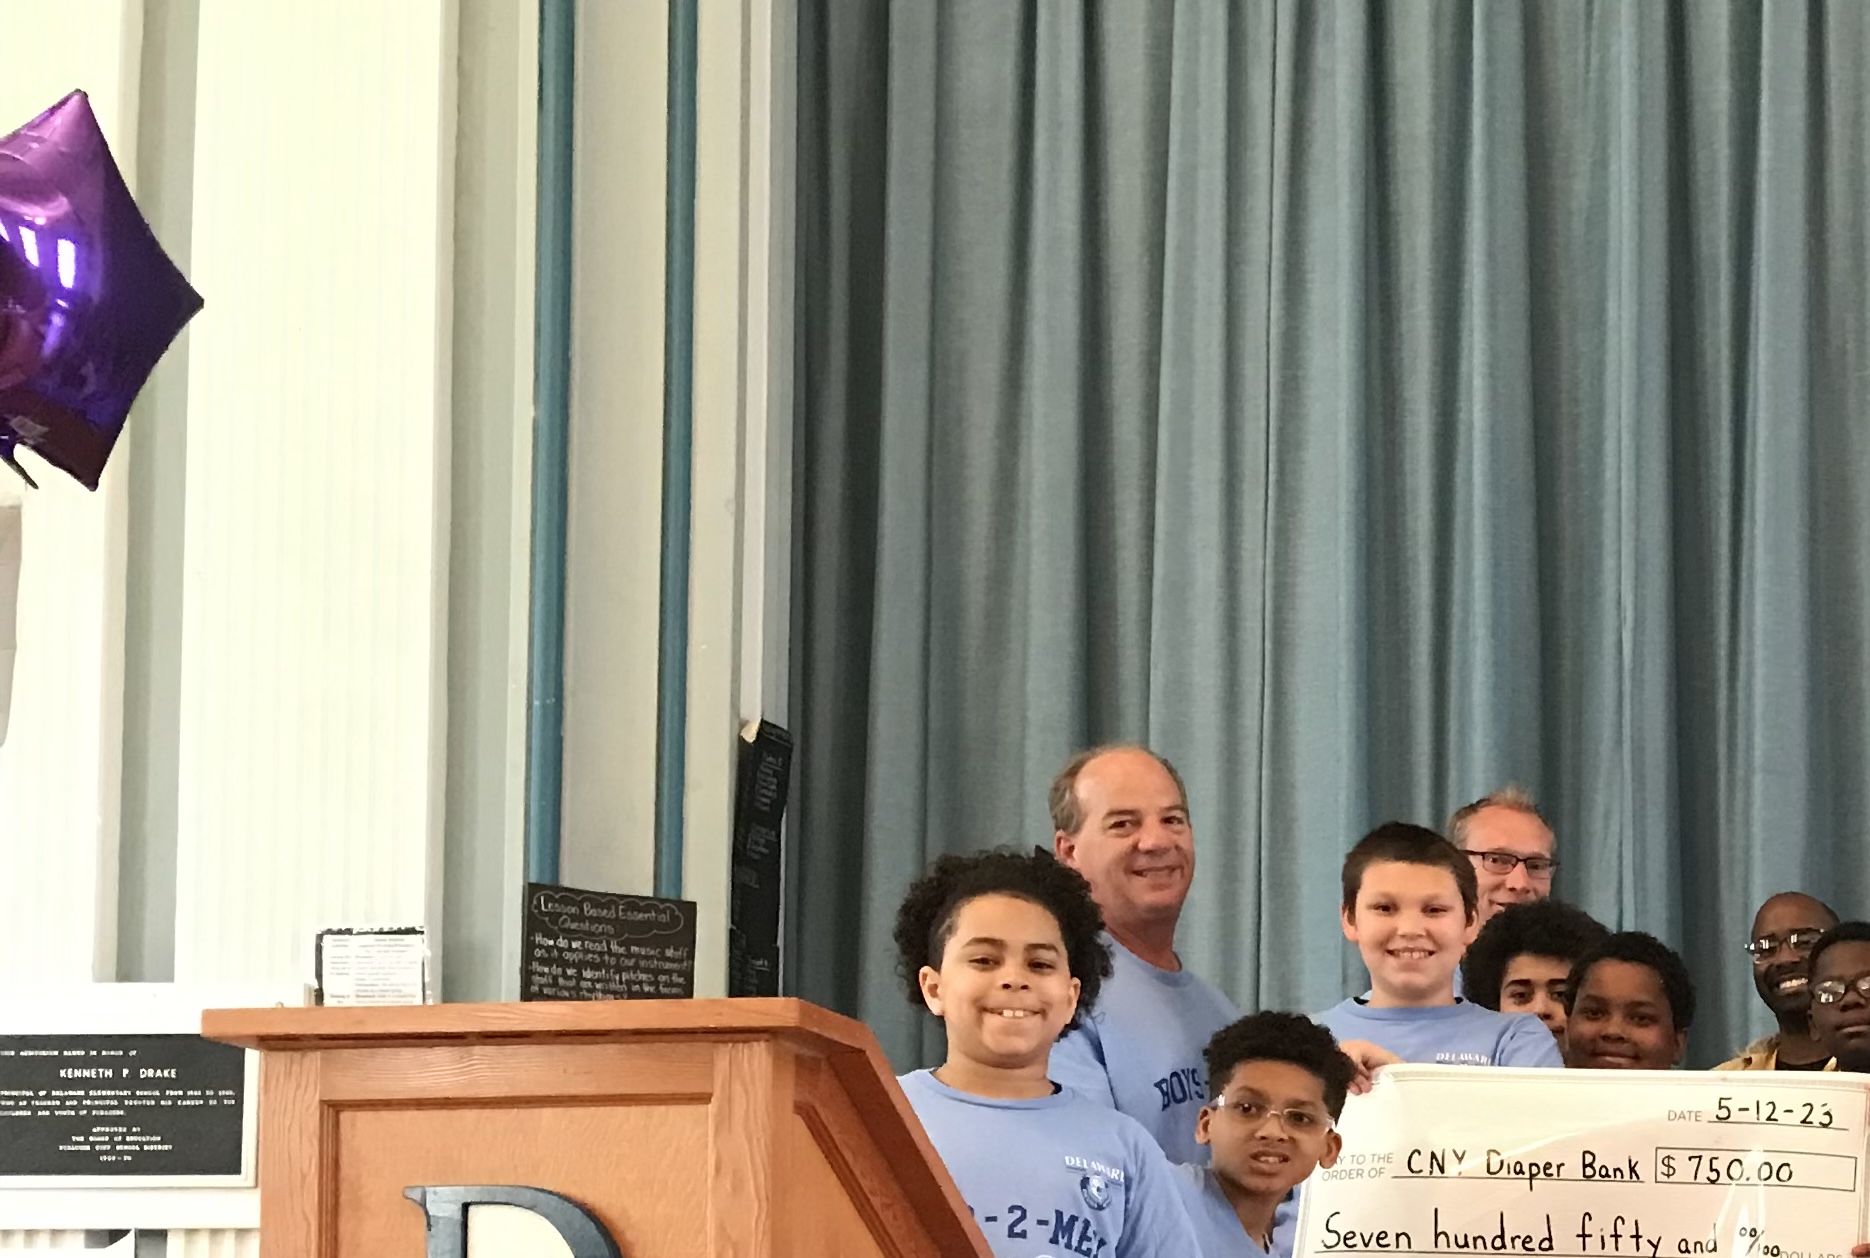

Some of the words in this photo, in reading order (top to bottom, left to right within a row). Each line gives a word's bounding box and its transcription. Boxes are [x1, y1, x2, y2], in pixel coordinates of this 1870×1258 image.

[540, 895, 580, 915] Lesson
[583, 901, 617, 919] Based
[619, 904, 671, 922] Essential
[558, 914, 615, 935] Questions
[535, 931, 555, 947] How
[556, 935, 569, 948] do
[584, 939, 608, 952] read
[609, 939, 628, 955] the
[630, 944, 662, 958] music
[562, 950, 601, 964] applies
[602, 953, 617, 966] to
[59, 1068, 113, 1079] KENNETH
[139, 1068, 177, 1079] DRAKE
[1667, 1110, 1703, 1122] DATE
[1714, 1096, 1834, 1128] 5-12-23
[1350, 1154, 1367, 1165] TO
[1370, 1152, 1394, 1164] THE
[1407, 1148, 1467, 1176] CNY
[1485, 1148, 1566, 1192] Diaper
[1581, 1149, 1642, 1181] Bank
[1660, 1154, 1677, 1179] $
[1687, 1154, 1794, 1184] 750.00
[1321, 1168, 1366, 1182] ORDER
[1368, 1167, 1386, 1179] OF
[1321, 1210, 1412, 1250] Seven
[1433, 1207, 1555, 1252] hundred
[1677, 1222, 1718, 1254] and
